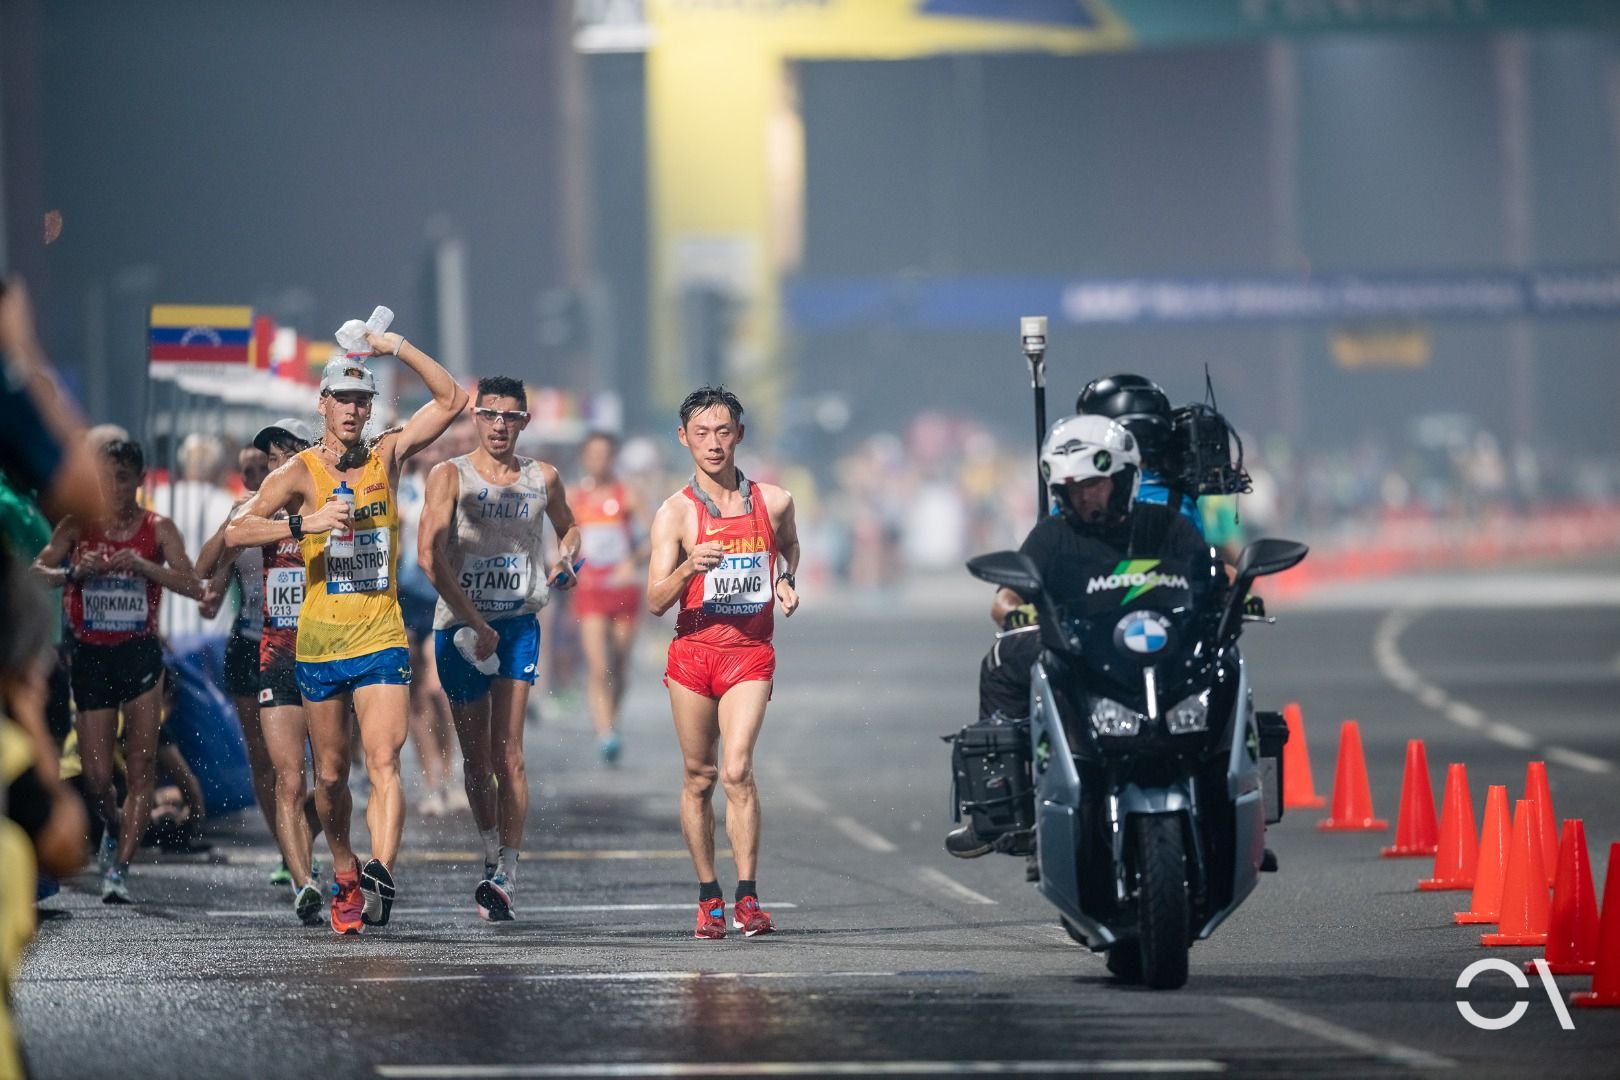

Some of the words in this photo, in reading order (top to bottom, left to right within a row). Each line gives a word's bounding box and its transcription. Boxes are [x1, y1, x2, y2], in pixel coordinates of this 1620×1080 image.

[354, 501, 387, 521] EDEN
[481, 503, 529, 519] ITALIA
[712, 536, 766, 553] HINA
[485, 557, 518, 569] TDK
[728, 556, 762, 570] TDK
[328, 571, 353, 582] 1710
[461, 572, 521, 591] STANO
[1086, 571, 1189, 594] MOTOCAM
[339, 578, 388, 592] DOHA2019
[714, 576, 762, 593] WANG
[463, 589, 482, 600] 112
[711, 593, 732, 603] 470
[85, 595, 145, 612] KORKMAZ
[475, 601, 515, 611] OHA2019
[715, 604, 764, 615] DOHA2019
[269, 606, 292, 616] 1213
